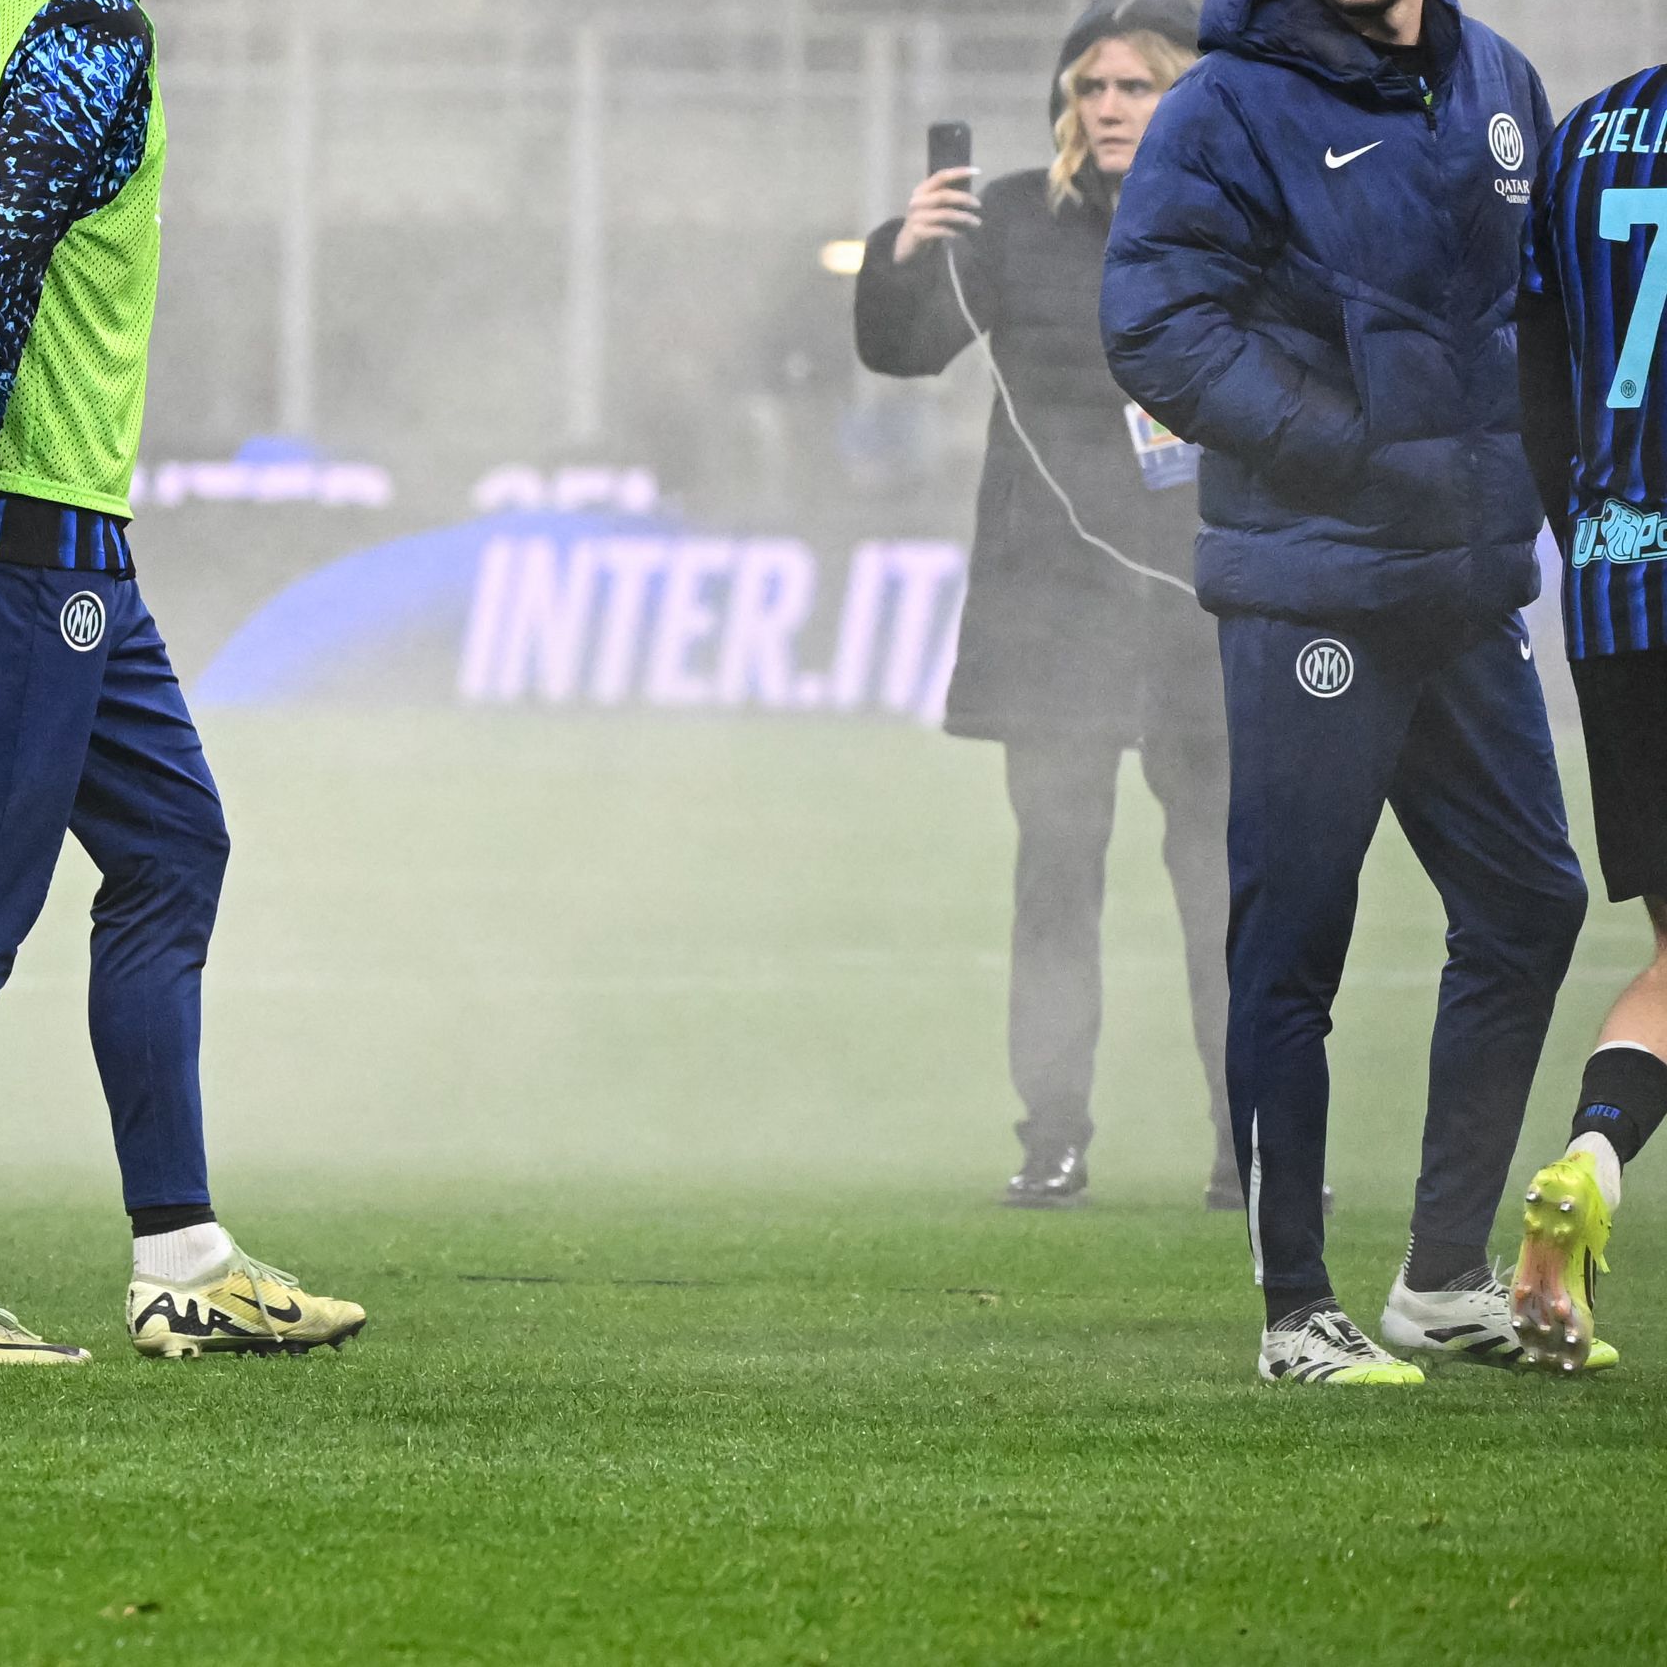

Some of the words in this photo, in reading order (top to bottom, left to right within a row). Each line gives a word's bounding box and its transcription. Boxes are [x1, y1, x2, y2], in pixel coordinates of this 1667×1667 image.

[1494, 178, 1531, 196] QATAR
[1578, 108, 1667, 159] ZIELI
[1599, 188, 1667, 409] 7
[460, 538, 965, 719] INTER.IT
